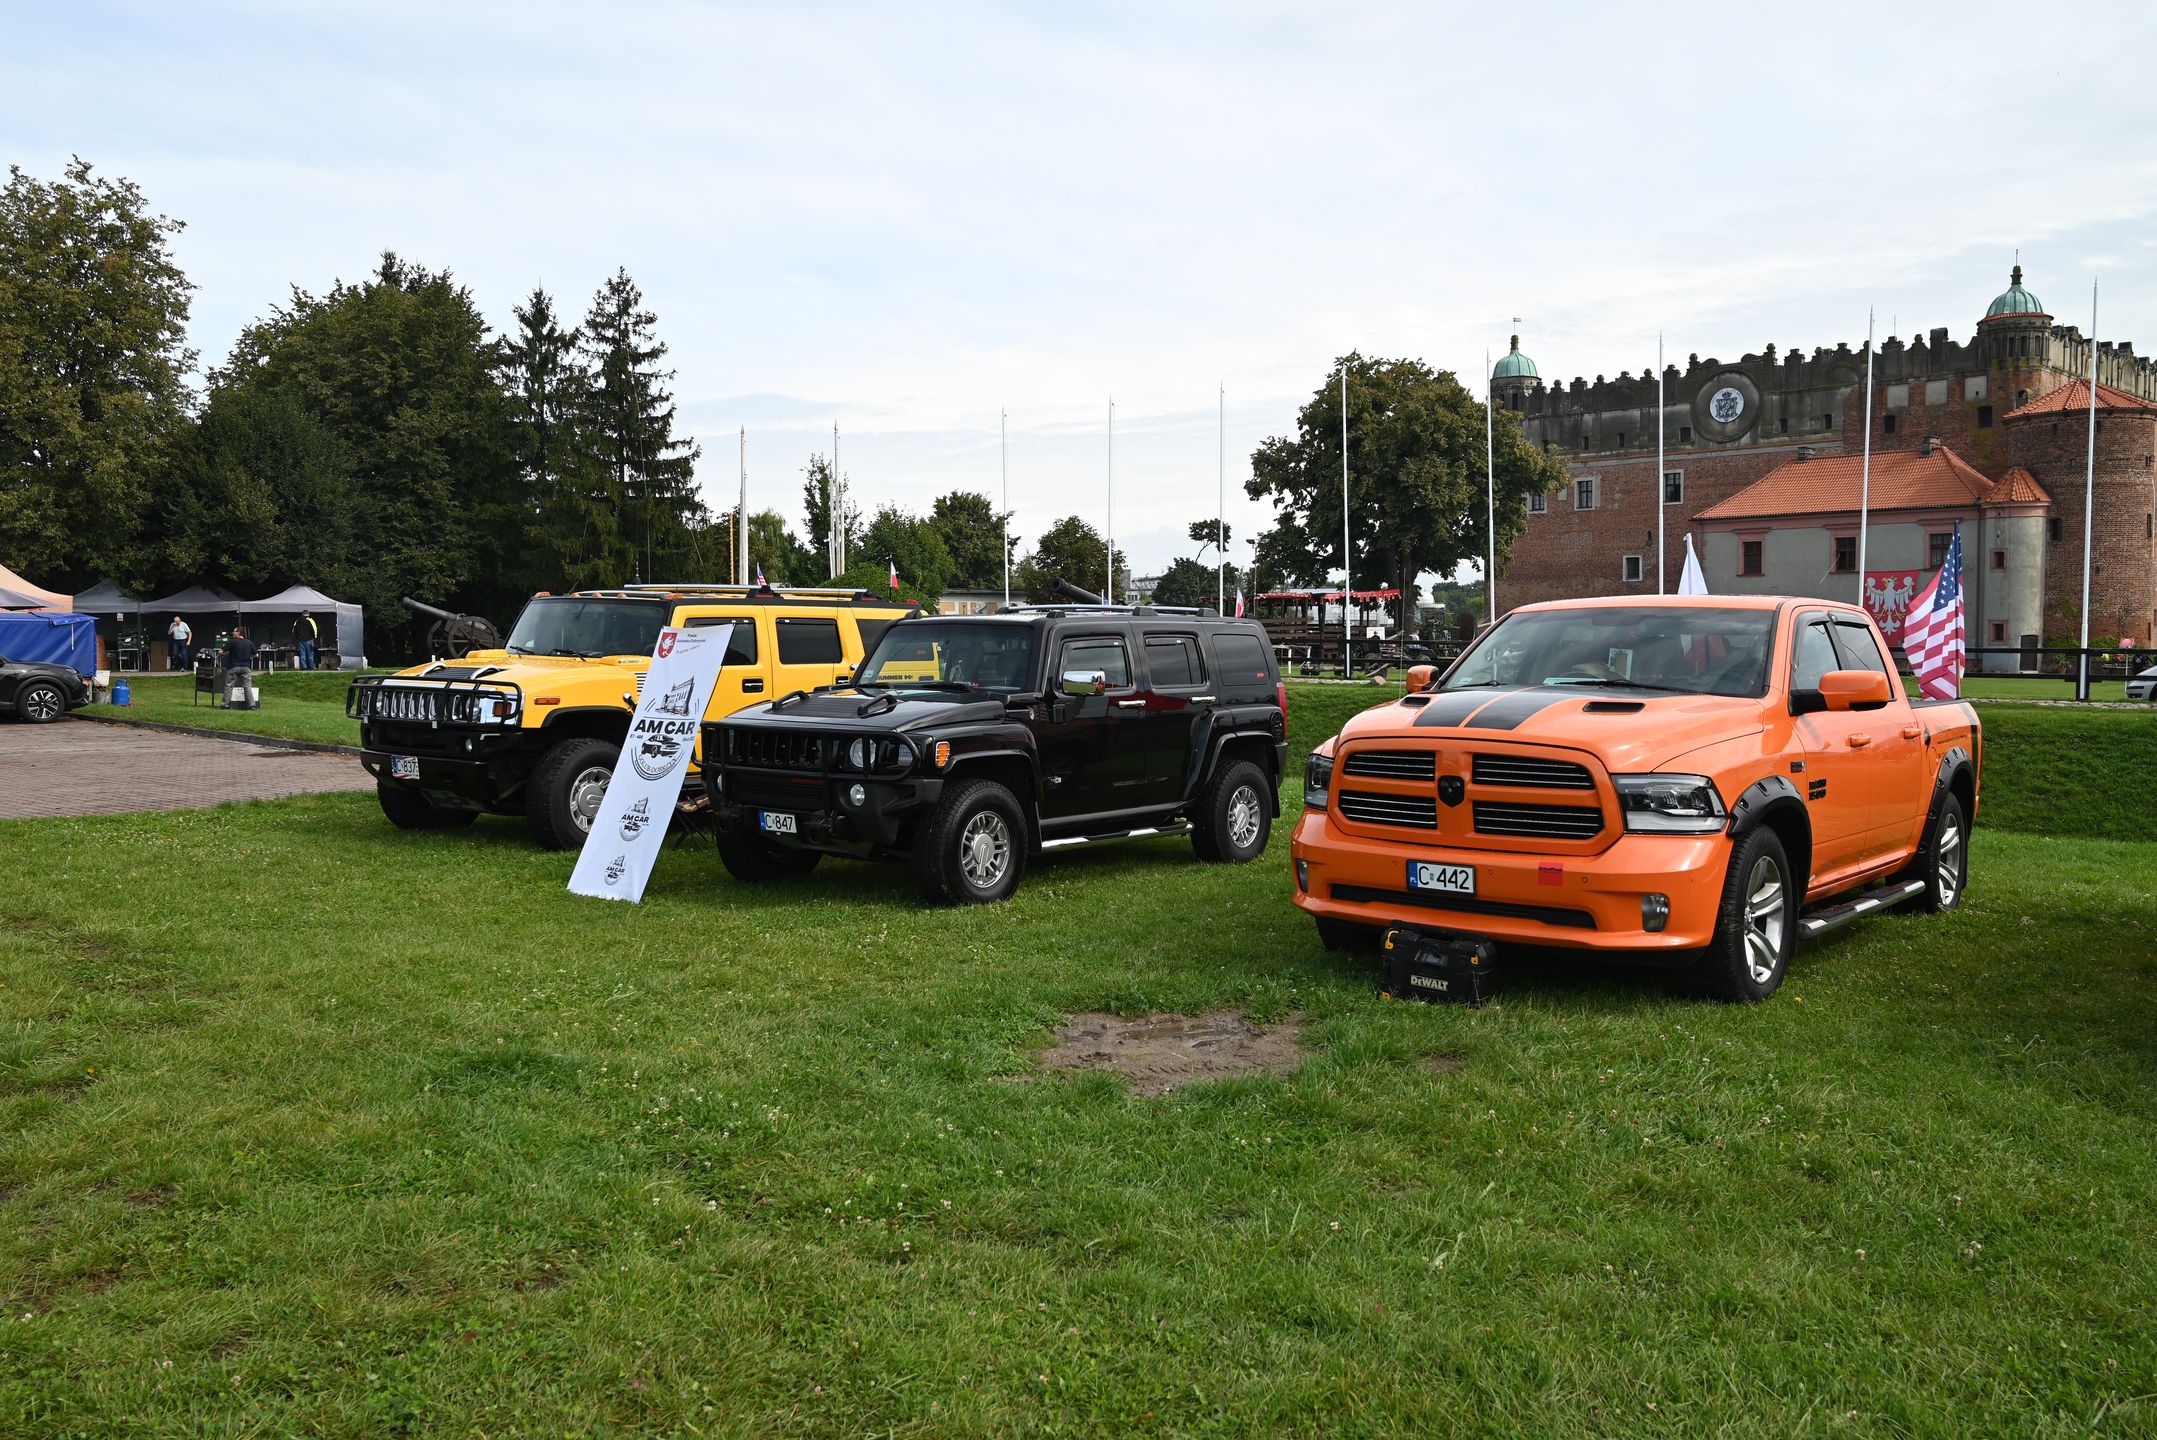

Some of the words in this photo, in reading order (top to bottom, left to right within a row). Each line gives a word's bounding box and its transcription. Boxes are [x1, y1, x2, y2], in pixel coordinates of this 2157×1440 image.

[634, 719, 664, 733] AM
[664, 721, 695, 735] CAR
[404, 760, 416, 773] 837
[765, 814, 772, 828] C
[775, 815, 793, 831] 847
[1419, 866, 1429, 885] C
[1437, 868, 1470, 890] 442
